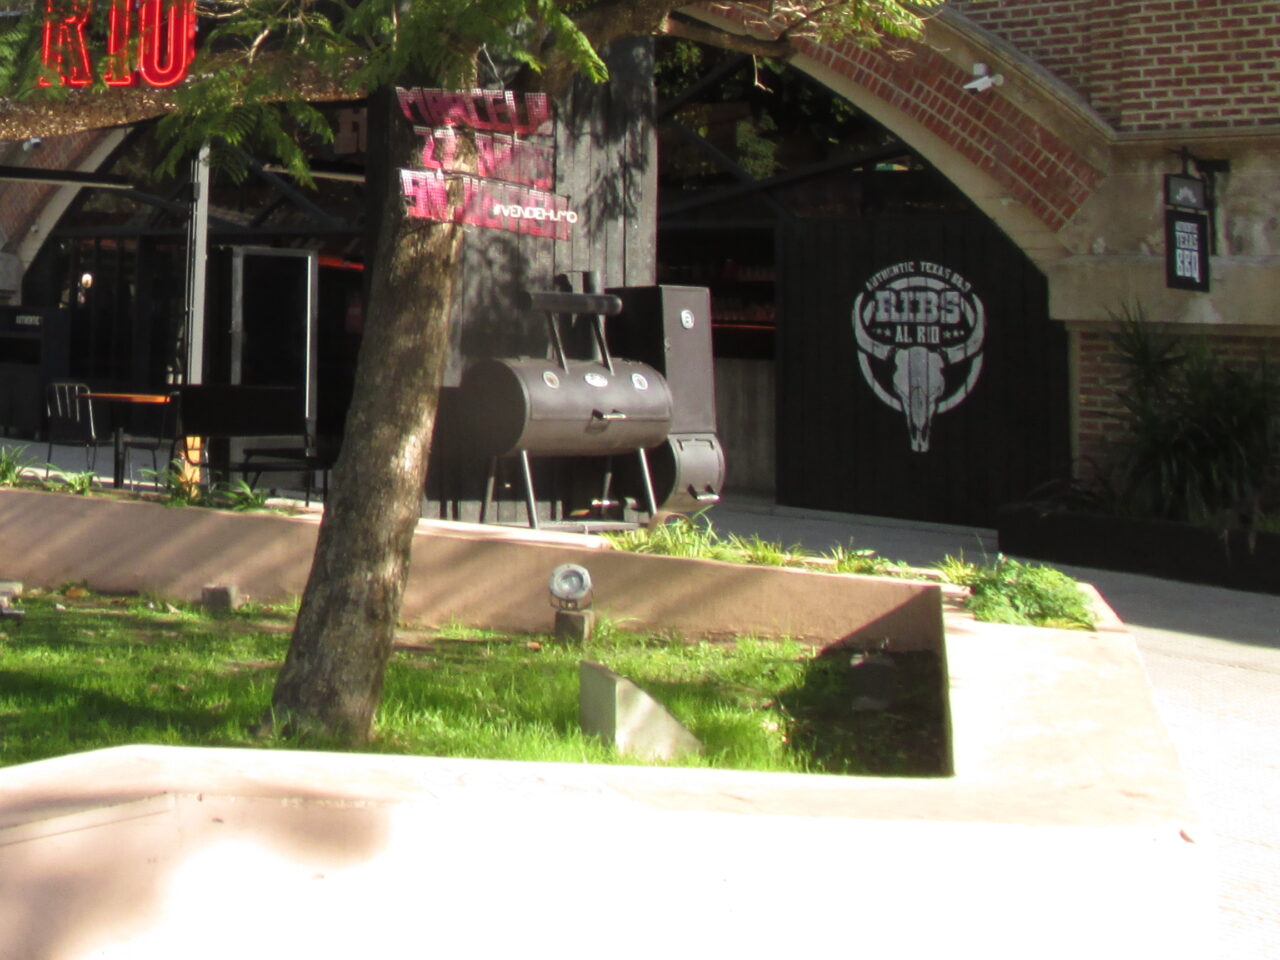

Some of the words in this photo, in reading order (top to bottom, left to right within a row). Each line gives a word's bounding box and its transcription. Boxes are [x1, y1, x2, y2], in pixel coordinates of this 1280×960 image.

[865, 261, 915, 291] AUTHENTIC
[920, 261, 951, 280] TEXAS
[1176, 248, 1201, 282] BBQ
[874, 290, 962, 324] RIBS
[895, 325, 912, 343] AL
[917, 325, 940, 343] RIO
